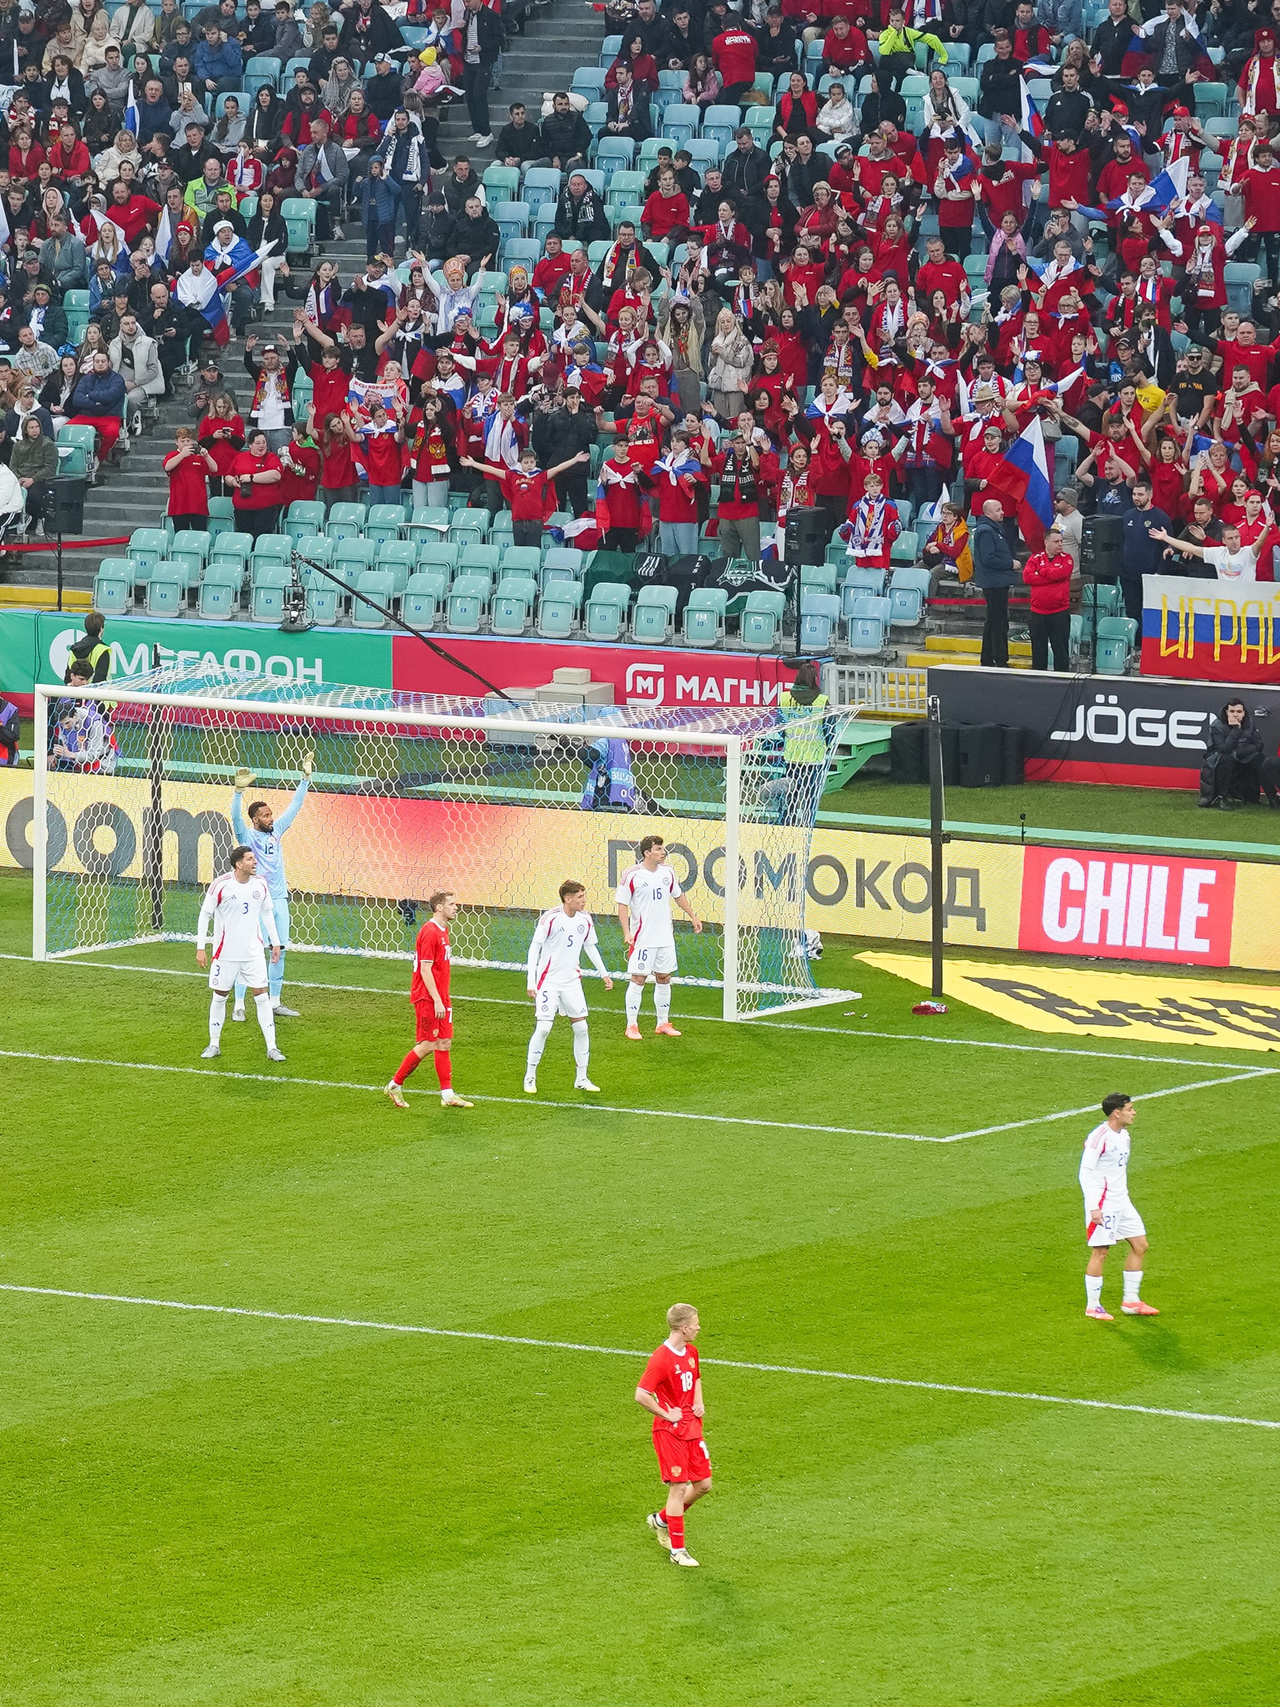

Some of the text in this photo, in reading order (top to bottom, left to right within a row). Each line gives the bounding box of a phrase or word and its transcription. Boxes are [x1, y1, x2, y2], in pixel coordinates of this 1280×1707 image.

[265, 843, 275, 855] 12
[652, 887, 662, 901] 16
[242, 902, 249, 914] 3
[1041, 857, 1217, 953] CHILE
[567, 934, 574, 948] 5
[637, 948, 648, 962] 16
[215, 964, 221, 977] 3
[542, 990, 549, 1004] 5
[680, 1370, 694, 1393] 18
